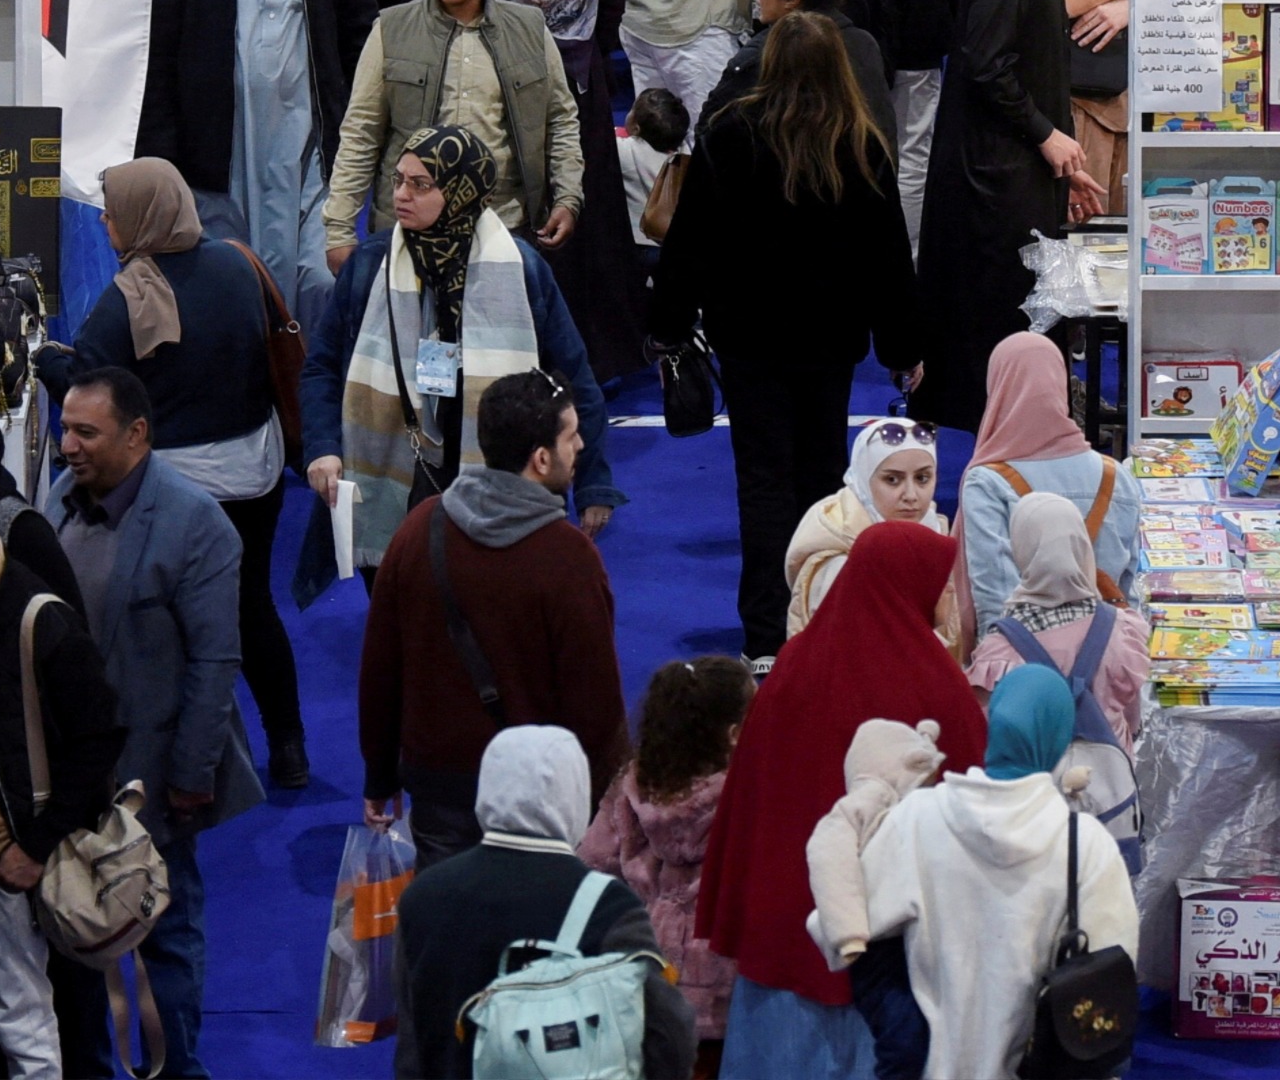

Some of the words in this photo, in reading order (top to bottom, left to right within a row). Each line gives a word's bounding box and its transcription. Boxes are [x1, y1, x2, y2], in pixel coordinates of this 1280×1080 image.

[1195, 0, 1216, 7] عرض
[1184, 83, 1203, 93] 400
[1215, 202, 1270, 215] Numbers
[1195, 937, 1266, 968] الذكي
